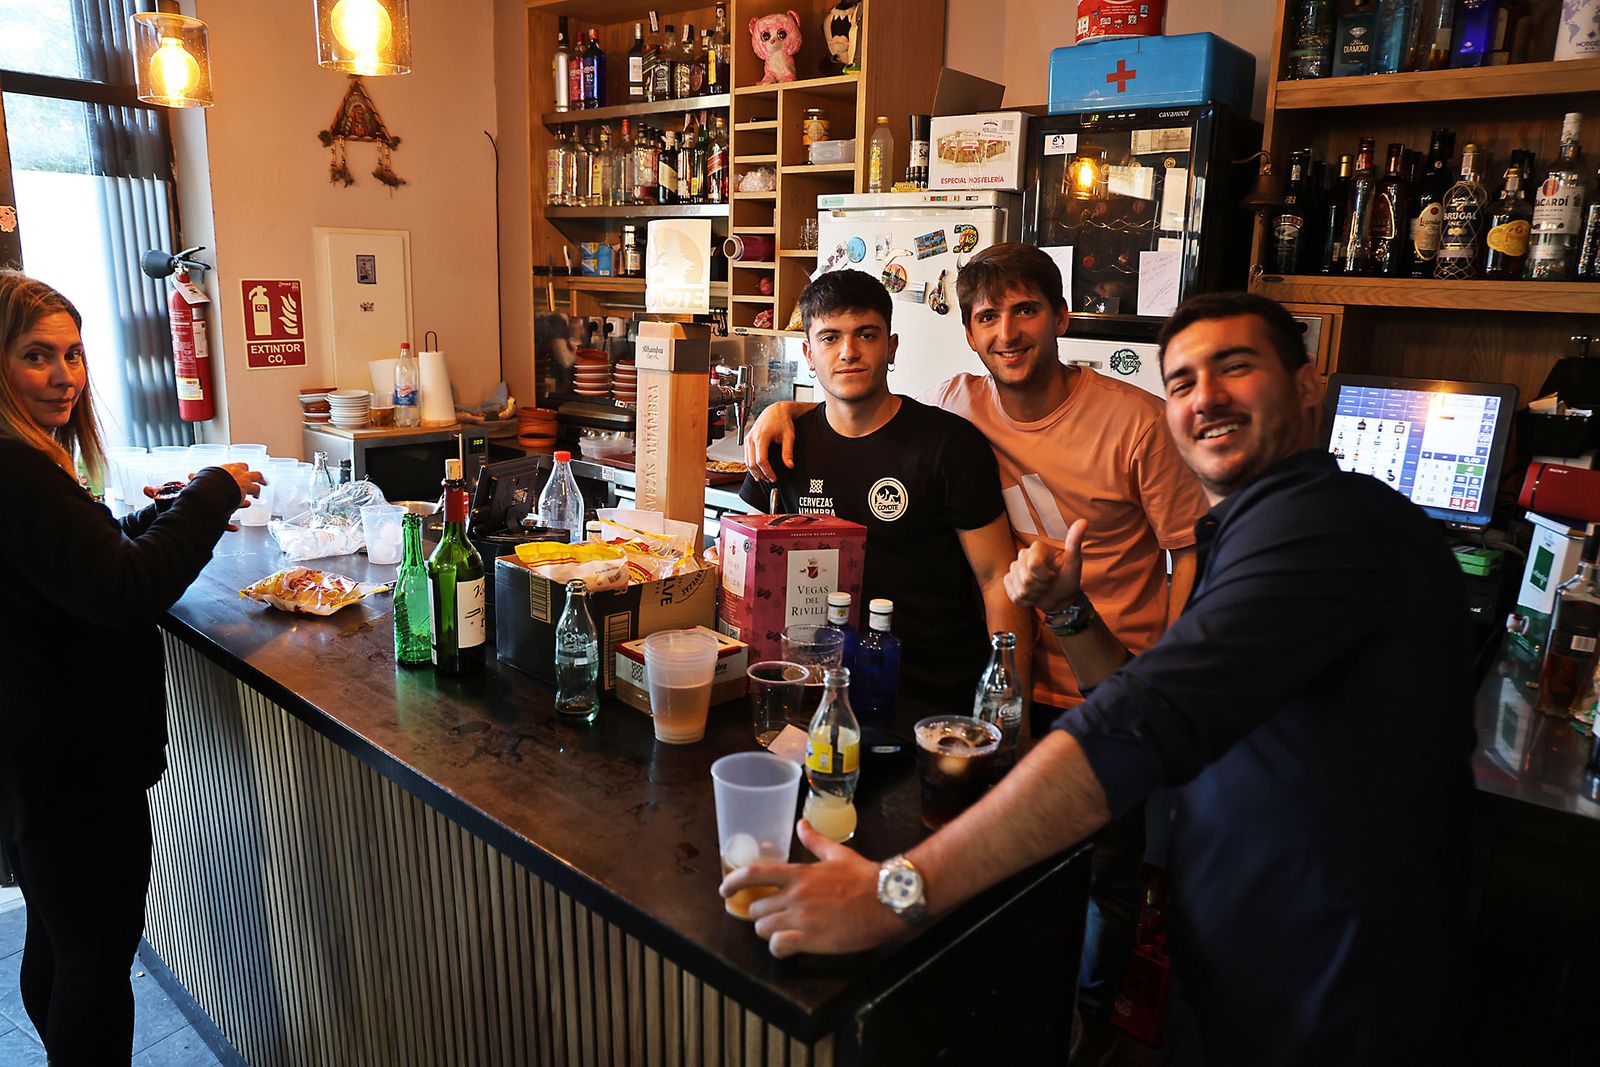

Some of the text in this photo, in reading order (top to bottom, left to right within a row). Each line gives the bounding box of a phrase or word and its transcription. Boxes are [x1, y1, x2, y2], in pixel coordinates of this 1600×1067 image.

[1343, 44, 1370, 53] DIAMOND
[968, 174, 1005, 184] HOSTELERÍA
[250, 343, 301, 354] EXTINTOR
[798, 496, 834, 508] CERVEZAS
[797, 585, 829, 595] VEGAS
[805, 597, 820, 605] DEL
[791, 606, 829, 617] RIVILL
